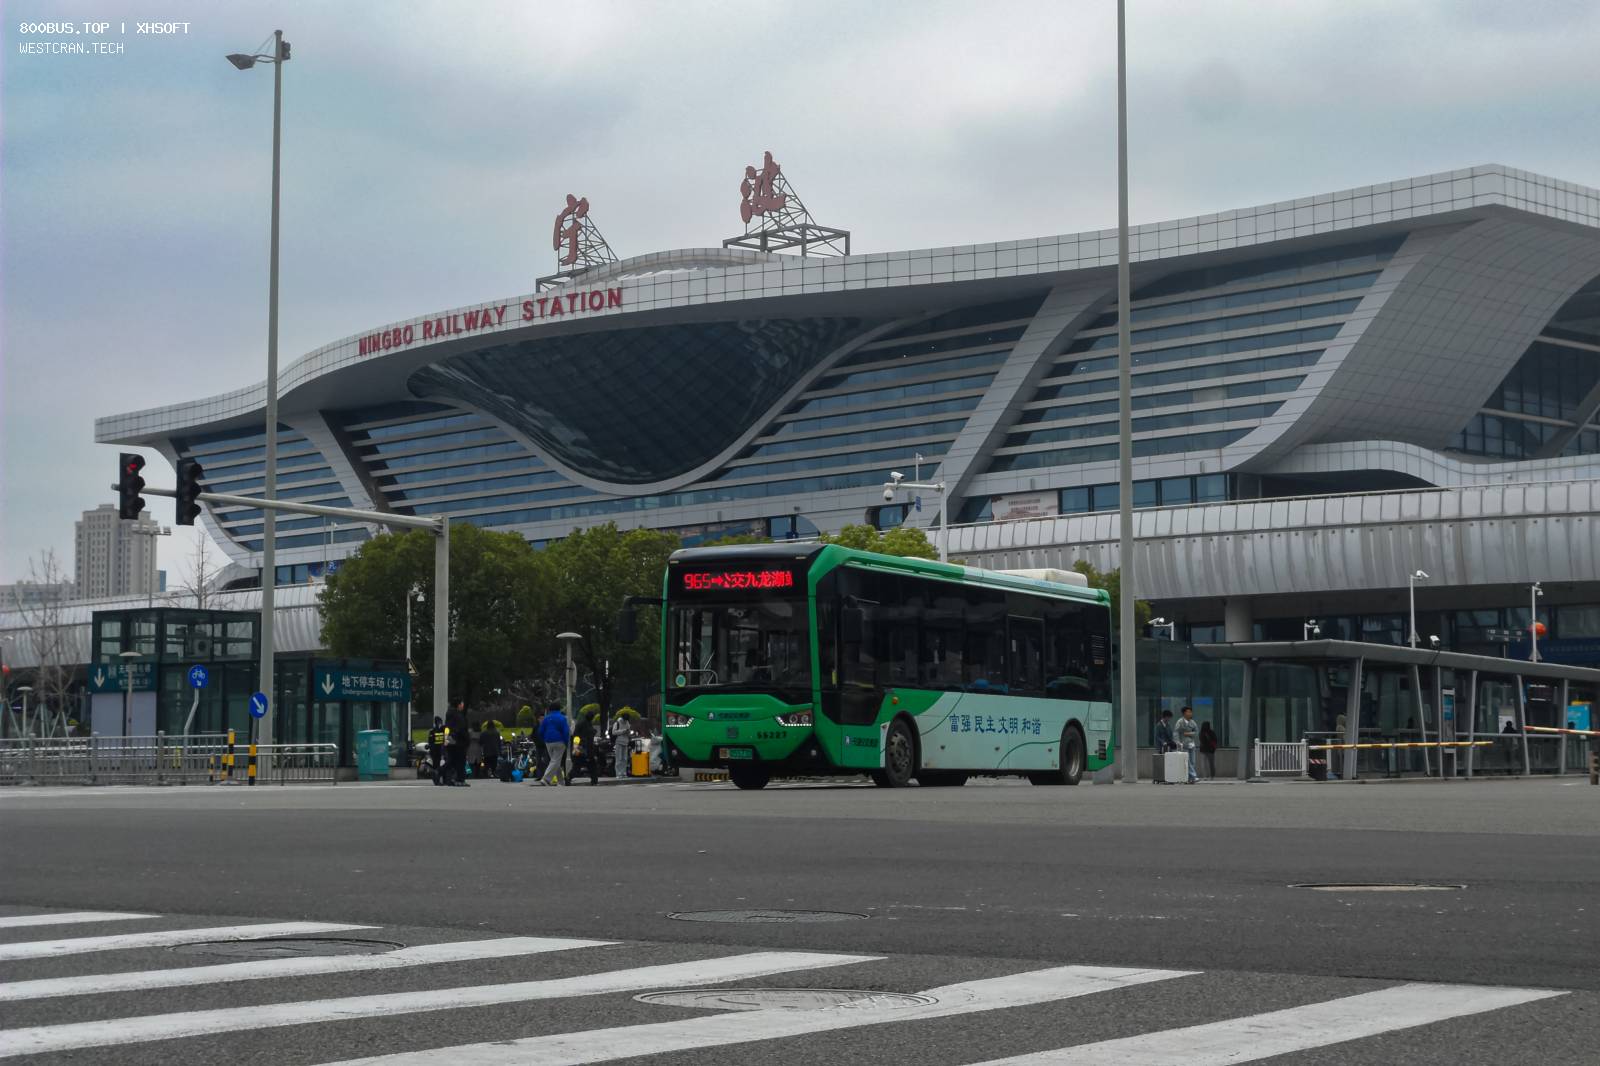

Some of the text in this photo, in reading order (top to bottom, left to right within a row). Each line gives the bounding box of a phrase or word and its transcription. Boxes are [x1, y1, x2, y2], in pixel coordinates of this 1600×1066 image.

[359, 287, 622, 356] NINGBO RAILWAY STATION
[684, 573, 711, 590] 965
